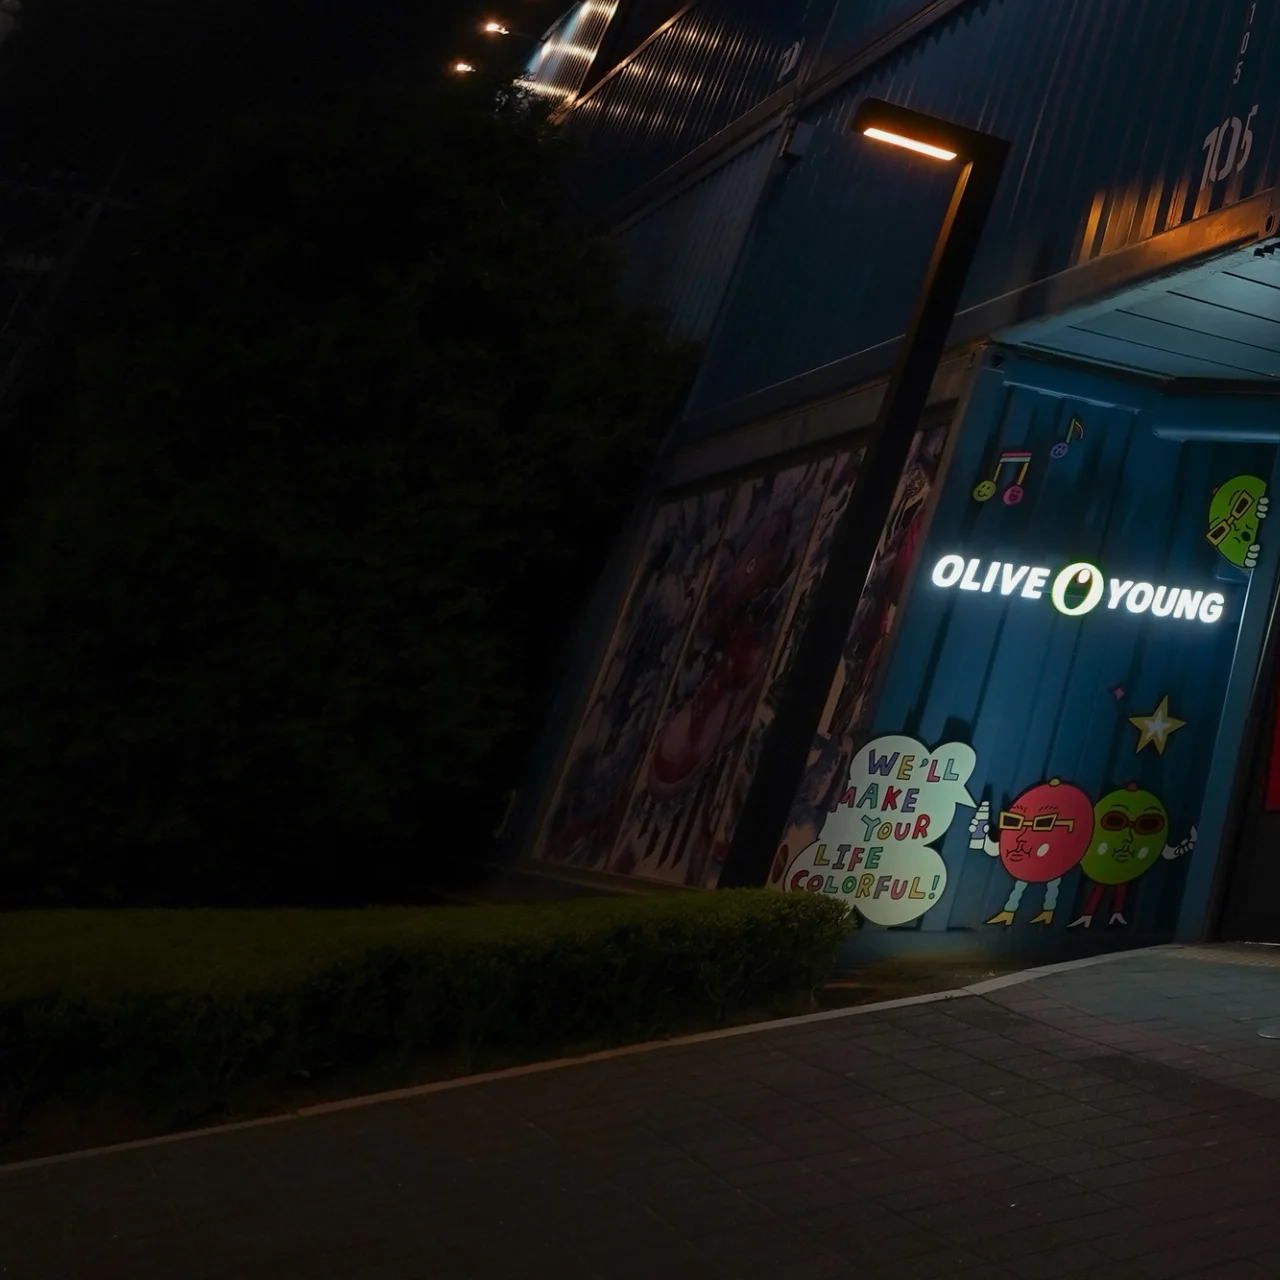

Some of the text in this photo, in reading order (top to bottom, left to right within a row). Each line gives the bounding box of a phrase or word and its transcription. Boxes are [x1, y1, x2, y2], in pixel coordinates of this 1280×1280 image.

[1231, 1, 1257, 86] 105
[1200, 103, 1261, 193] 105
[931, 553, 1051, 602] OLIVE
[1106, 577, 1226, 624] YOUNG
[868, 747, 960, 784] WE'LL
[834, 781, 920, 815] MAKE
[861, 811, 932, 843] YOUR
[813, 843, 884, 872] LIFE
[788, 869, 942, 903] COLORFUL!
